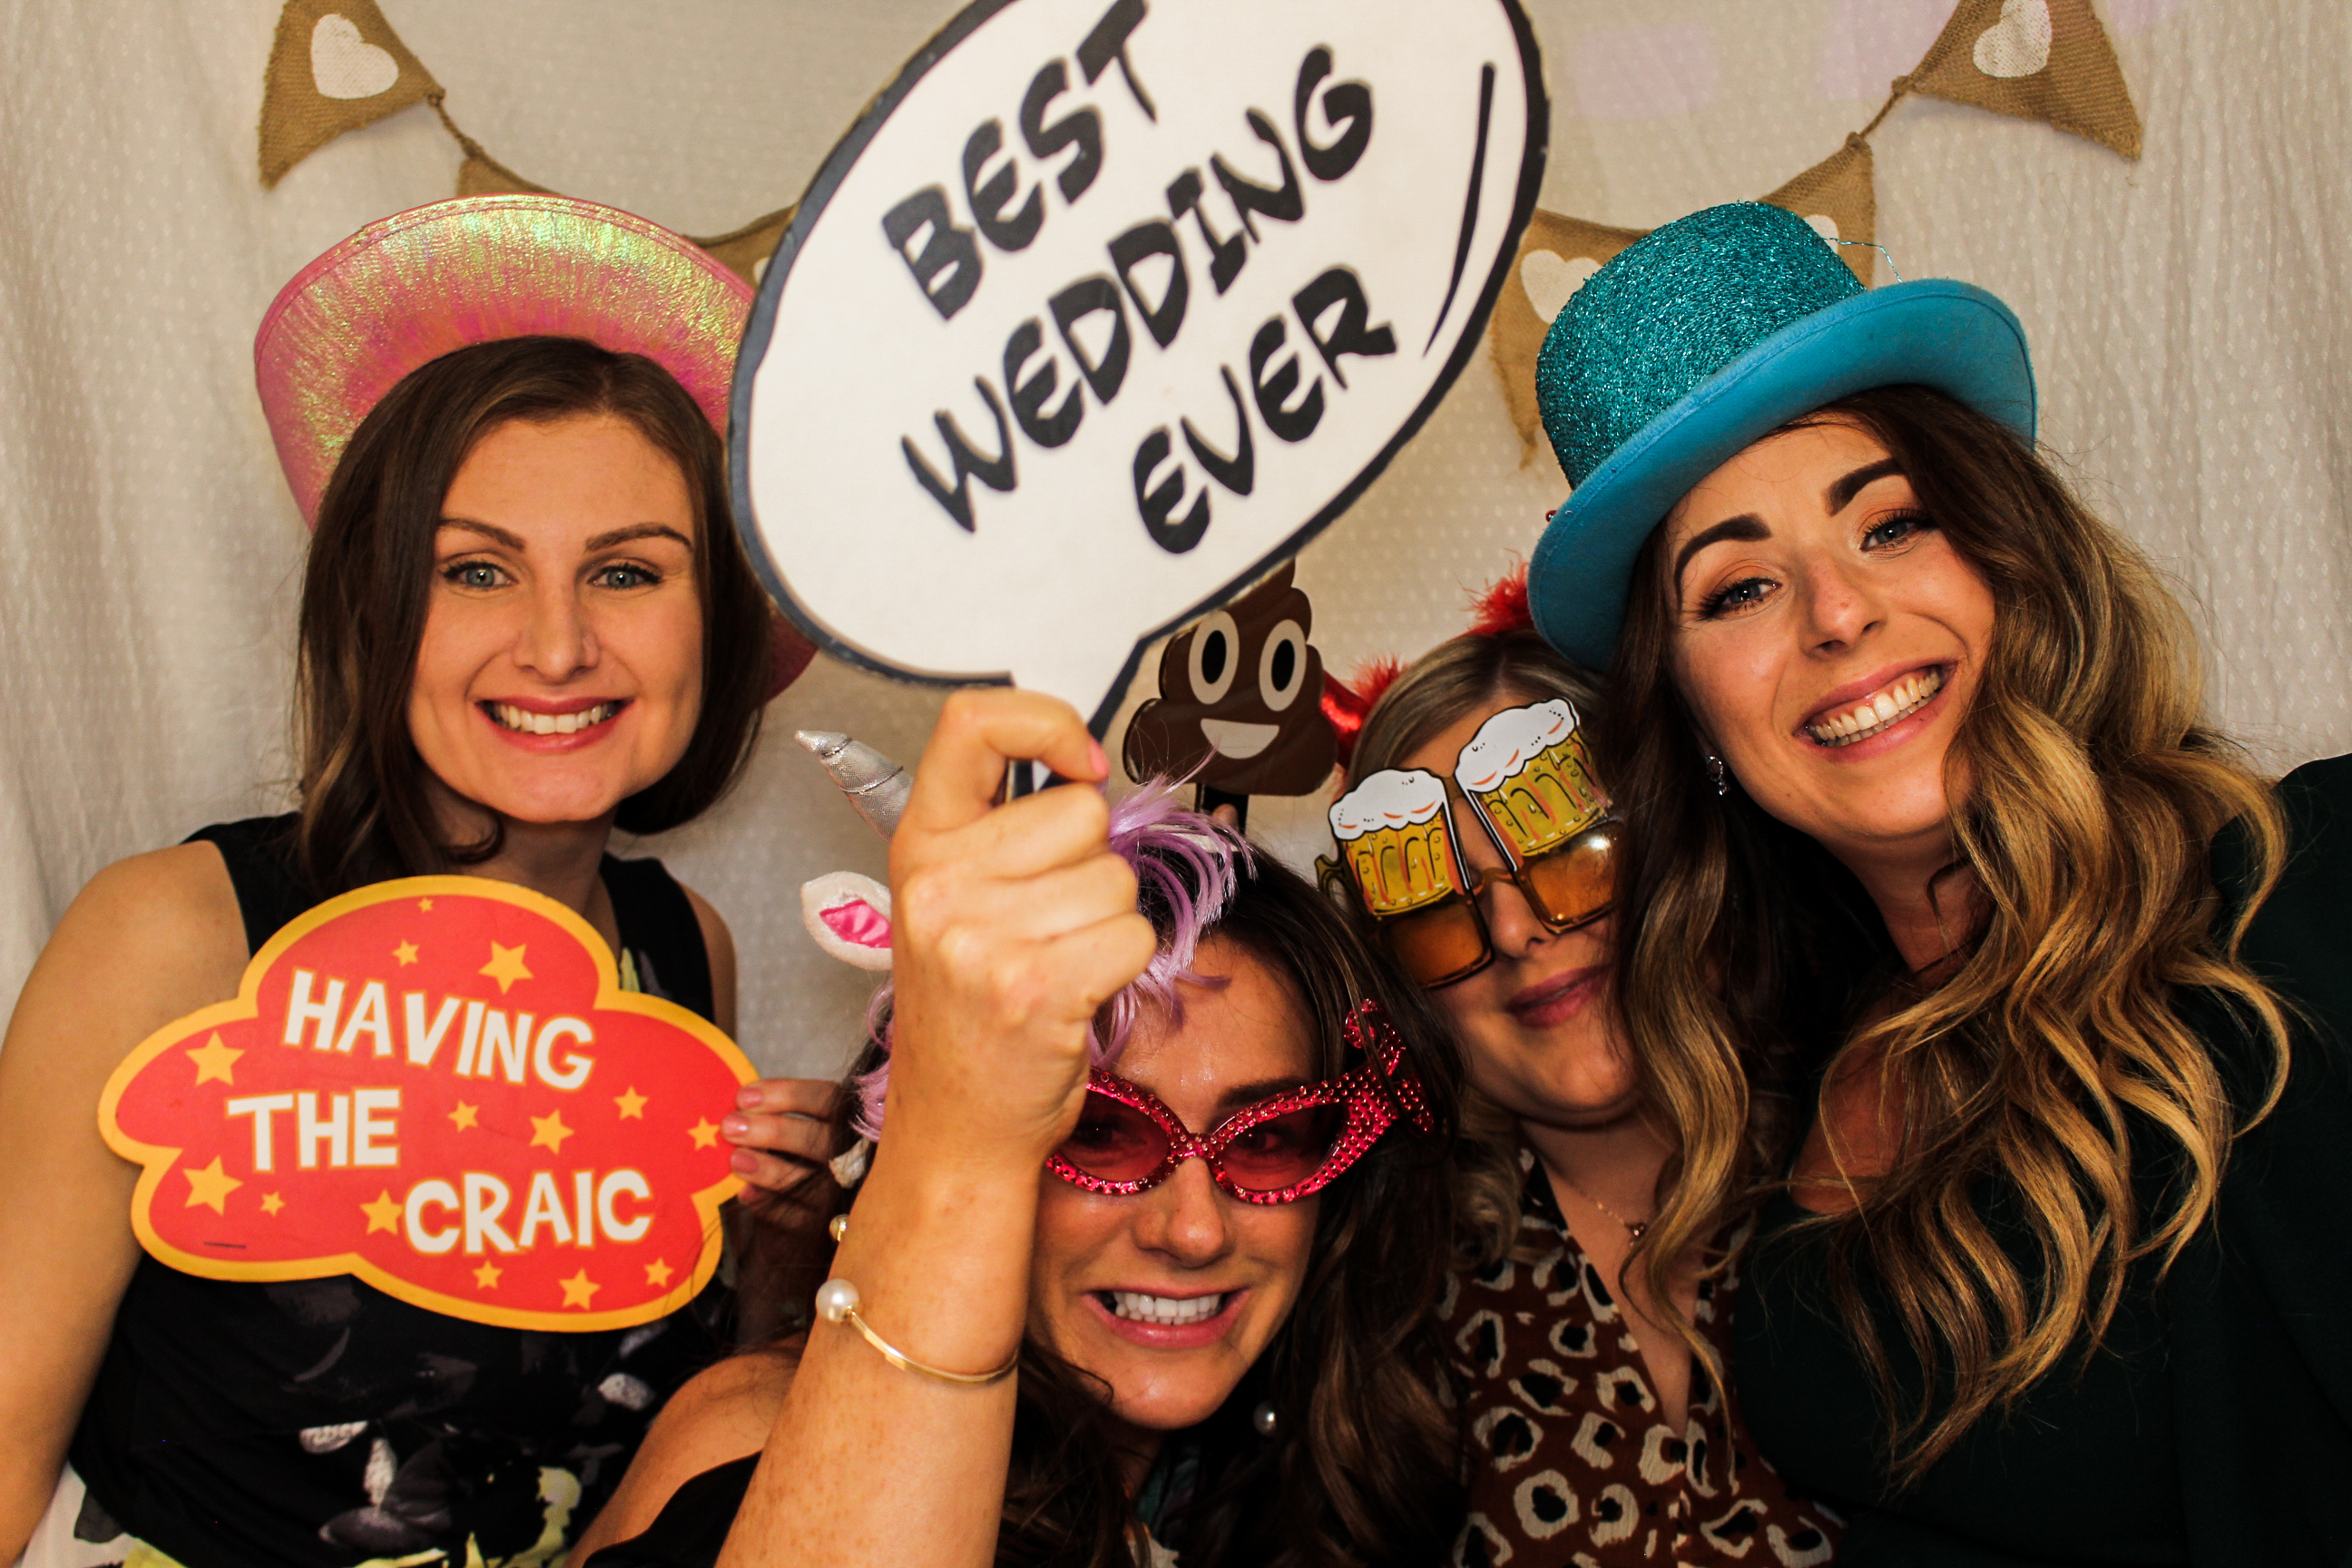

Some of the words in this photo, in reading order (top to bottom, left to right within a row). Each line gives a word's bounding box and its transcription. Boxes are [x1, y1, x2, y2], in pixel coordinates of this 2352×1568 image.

[880, 0, 1158, 321] BEST
[900, 44, 1374, 534] WEDDING
[1132, 263, 1397, 554] EVER
[226, 1087, 402, 1172] THE
[281, 968, 595, 1091] HAVING
[403, 1169, 652, 1256] CRAIC
